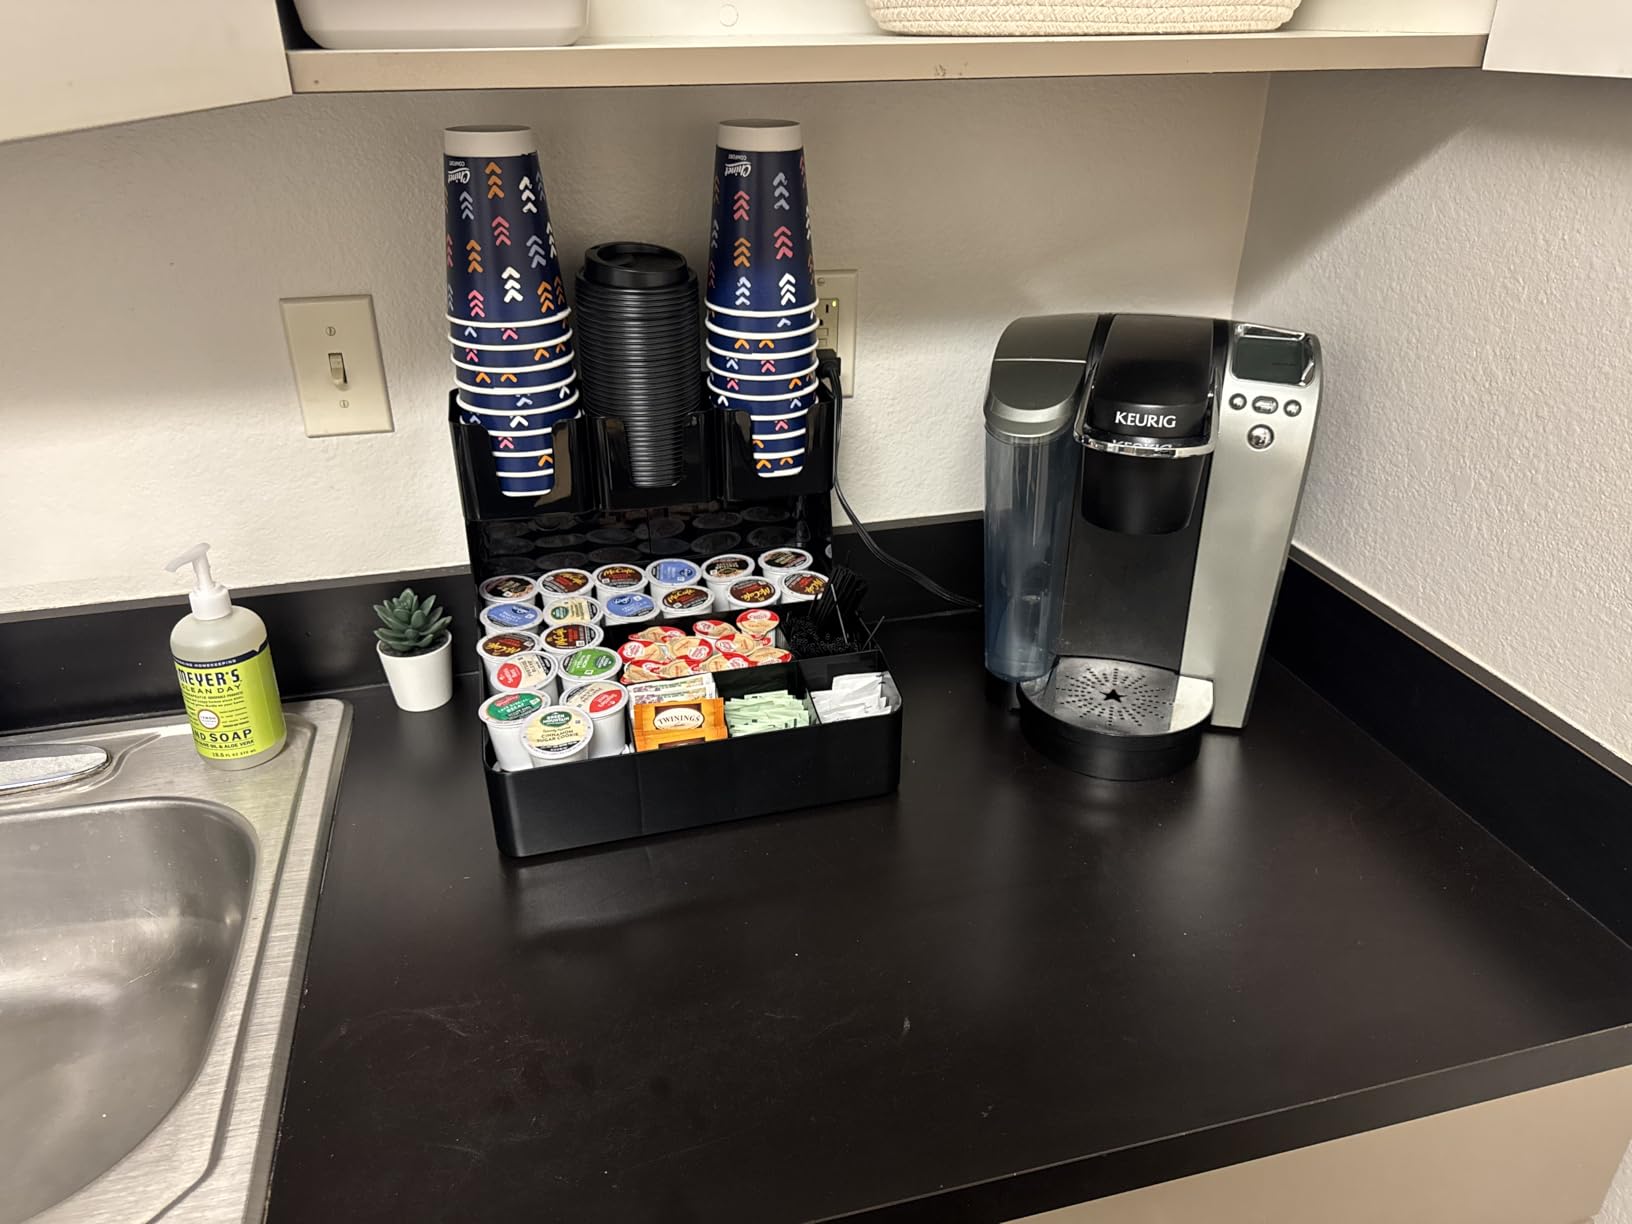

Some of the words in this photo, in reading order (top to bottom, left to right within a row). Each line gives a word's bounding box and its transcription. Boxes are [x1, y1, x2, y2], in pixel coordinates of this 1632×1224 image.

[725, 164, 751, 177] Chinet
[1114, 410, 1177, 429] KEURIG
[177, 668, 240, 687] MEYER'S
[181, 683, 213, 694] CLEAN
[217, 684, 241, 694] DAY
[658, 714, 700, 725] TWININGS
[209, 728, 252, 742] SOAP
[541, 730, 574, 739] CINNAMON
[557, 732, 579, 740] COOKIE
